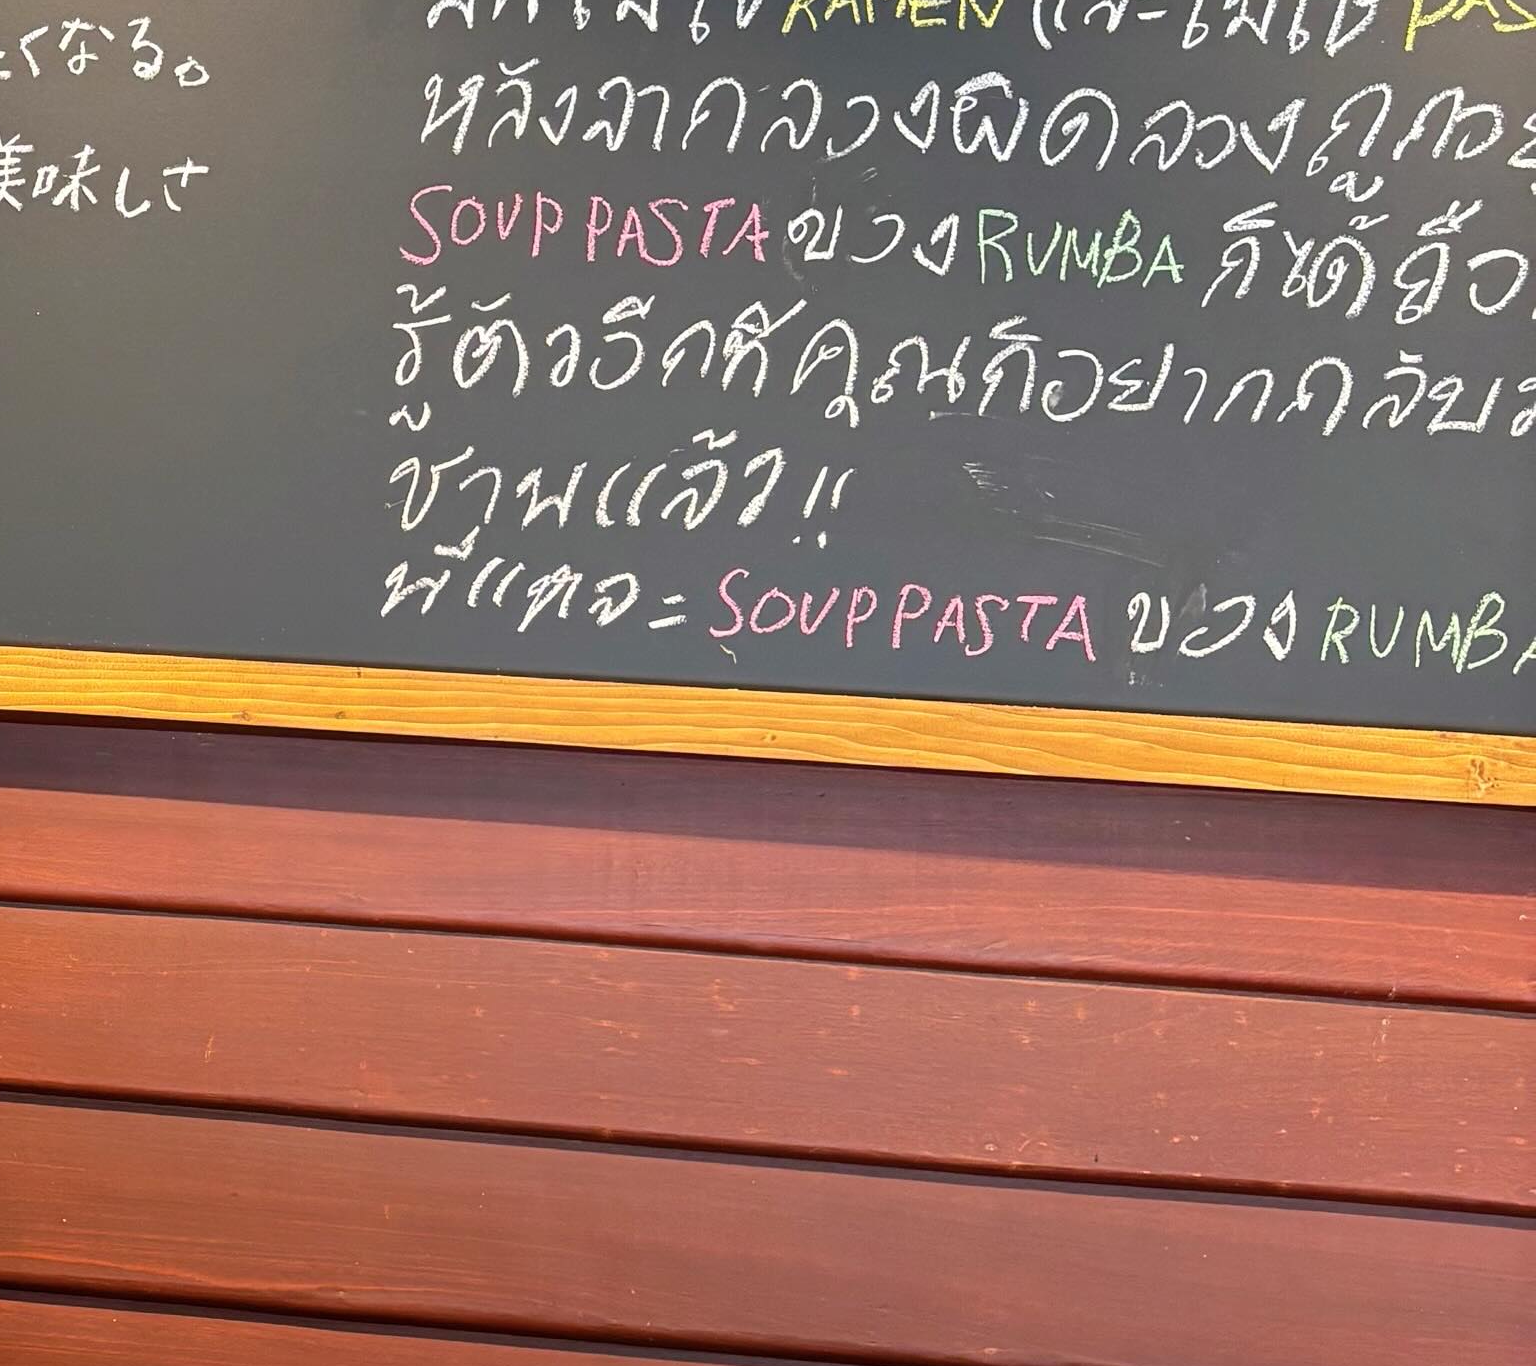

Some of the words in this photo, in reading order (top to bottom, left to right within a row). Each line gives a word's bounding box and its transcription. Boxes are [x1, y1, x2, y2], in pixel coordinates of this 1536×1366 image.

[399, 184, 565, 266] SOUP
[585, 196, 770, 267] PASTA
[977, 208, 1185, 290] RUMBA
[709, 568, 878, 649] SOUP
[891, 582, 1096, 662] PASTA
